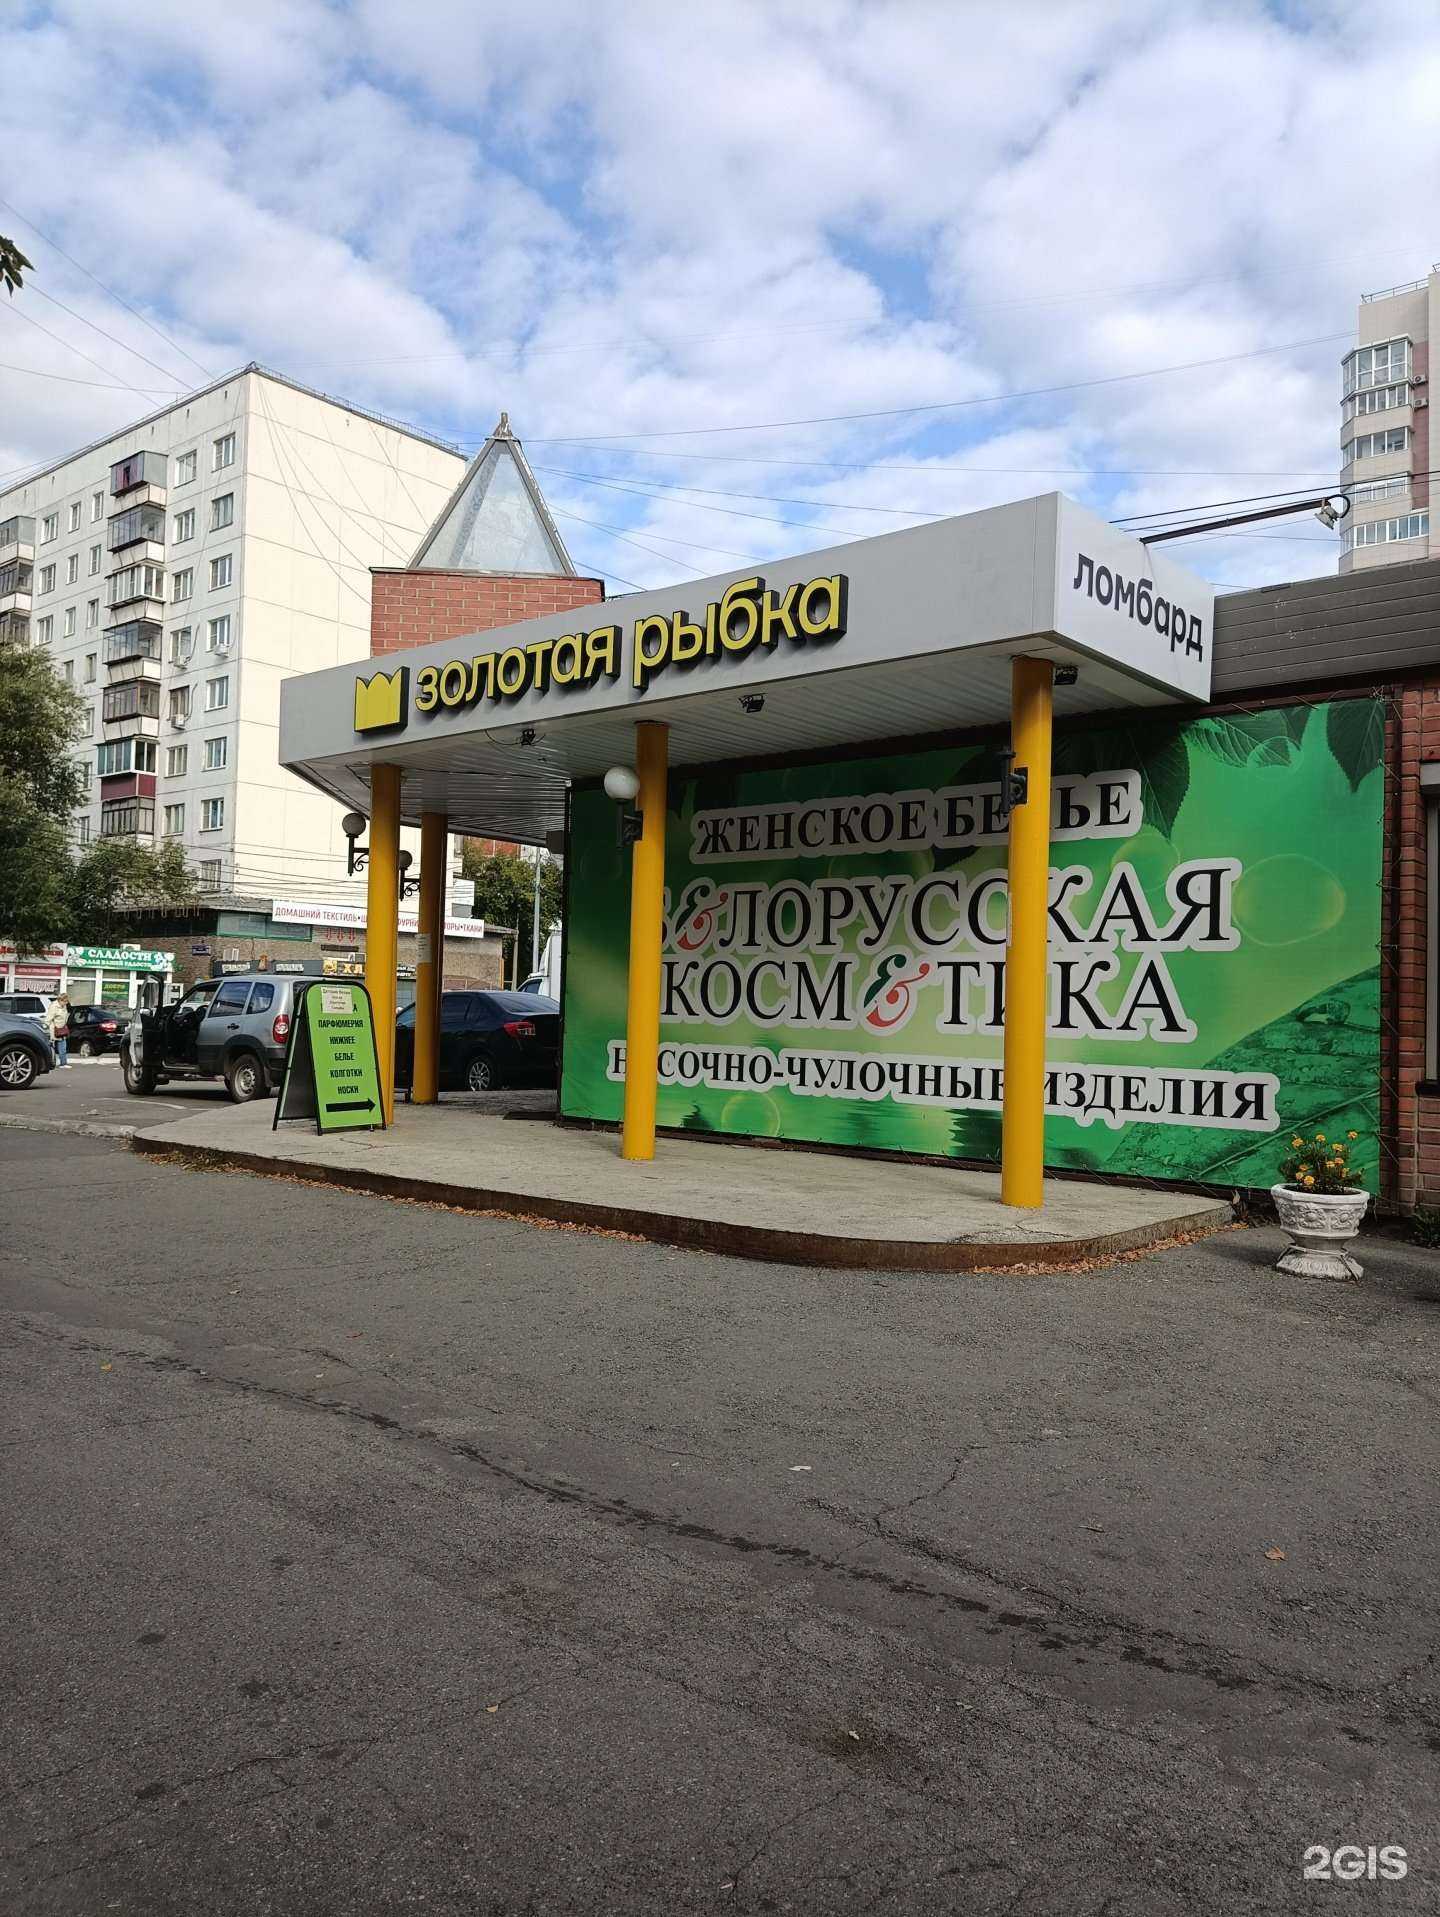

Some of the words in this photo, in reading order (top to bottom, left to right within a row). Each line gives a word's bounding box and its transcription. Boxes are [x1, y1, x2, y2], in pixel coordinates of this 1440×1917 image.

[1073, 553, 1203, 662] ломбард
[414, 625, 622, 713] золотая
[632, 574, 849, 689] рыбка
[697, 800, 927, 856] ЖЕНСКОЕ
[943, 781, 1132, 838] БЕЬЕ
[274, 905, 322, 919] ДОМАШНИЙ
[88, 949, 152, 961] СЛАДОСТИ
[318, 1019, 364, 1029] ПАРФЮМЕРИЯ
[329, 1036, 356, 1045] НИЖНЕЕ
[334, 1052, 355, 1061] БЕЛЬЕ
[329, 1068, 363, 1078] КОЛГОТКИ
[337, 1085, 359, 1095] НОСКИ
